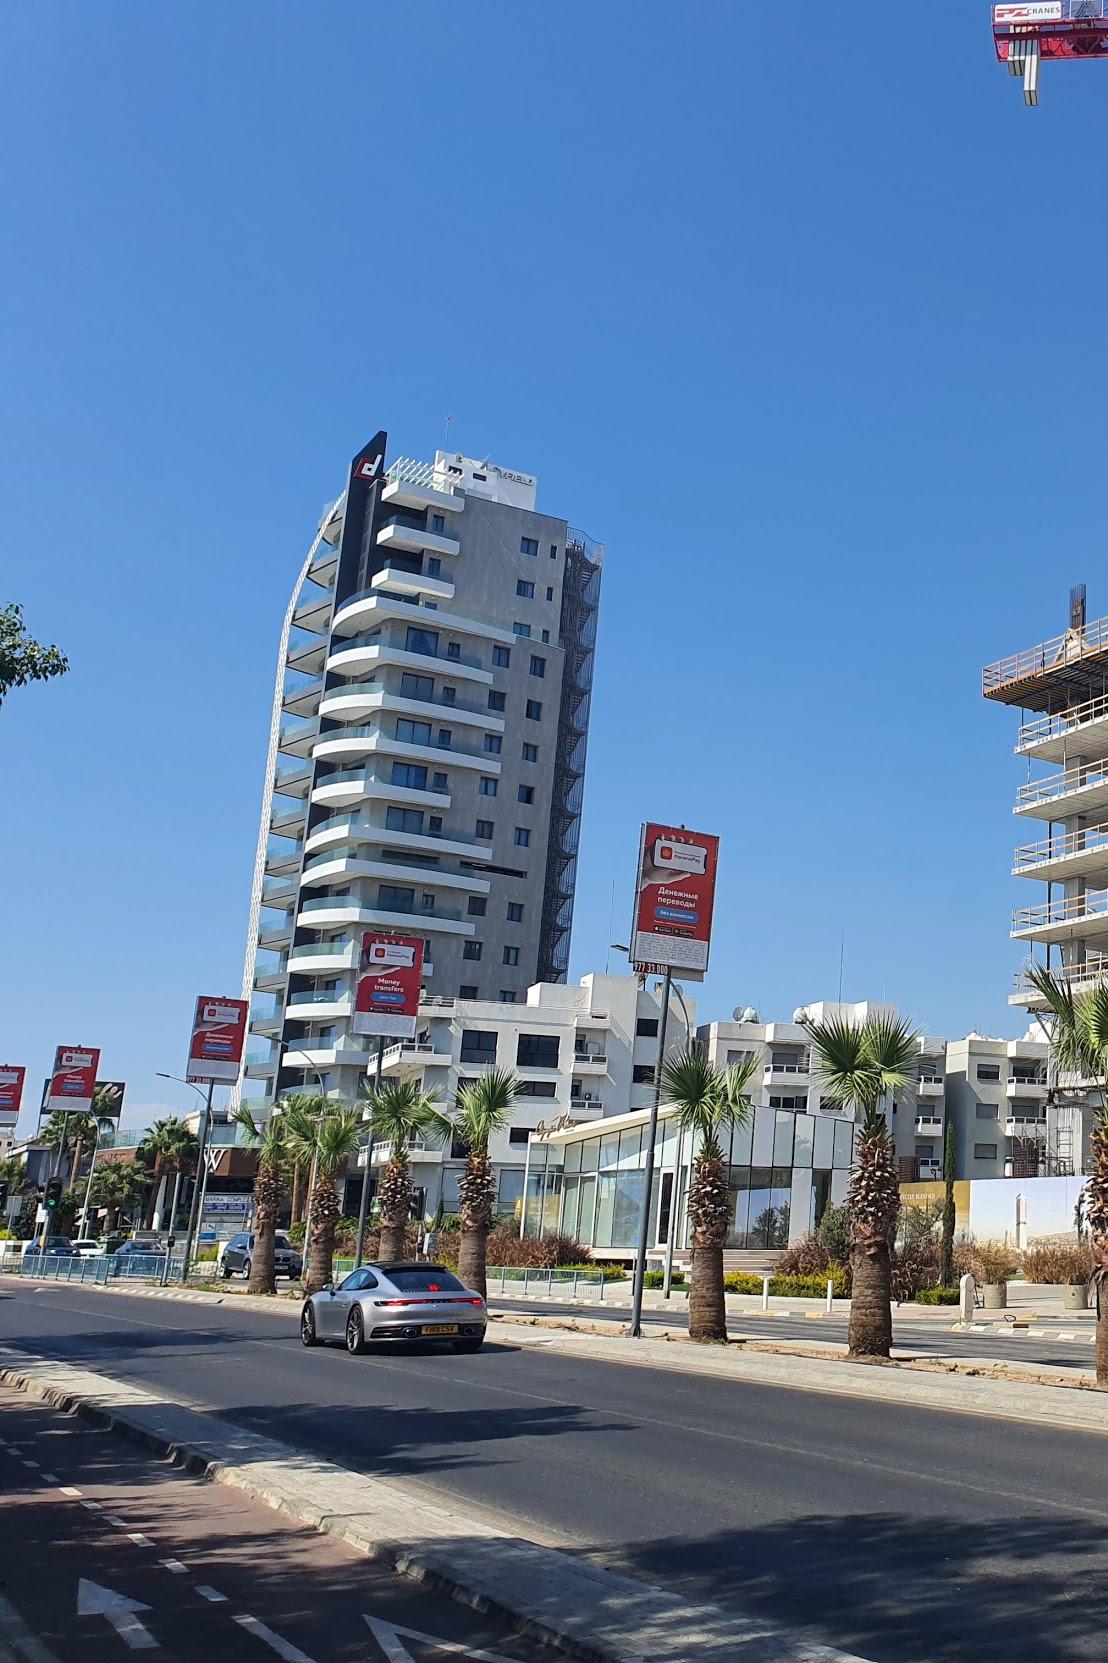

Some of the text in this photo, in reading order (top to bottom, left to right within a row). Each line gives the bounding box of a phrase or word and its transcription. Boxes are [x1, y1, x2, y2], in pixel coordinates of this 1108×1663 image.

[1027, 7, 1060, 15] CRANES
[658, 886, 699, 900] Денежные
[658, 896, 696, 909] переводы
[378, 978, 400, 987] Money
[374, 984, 404, 993] transfers
